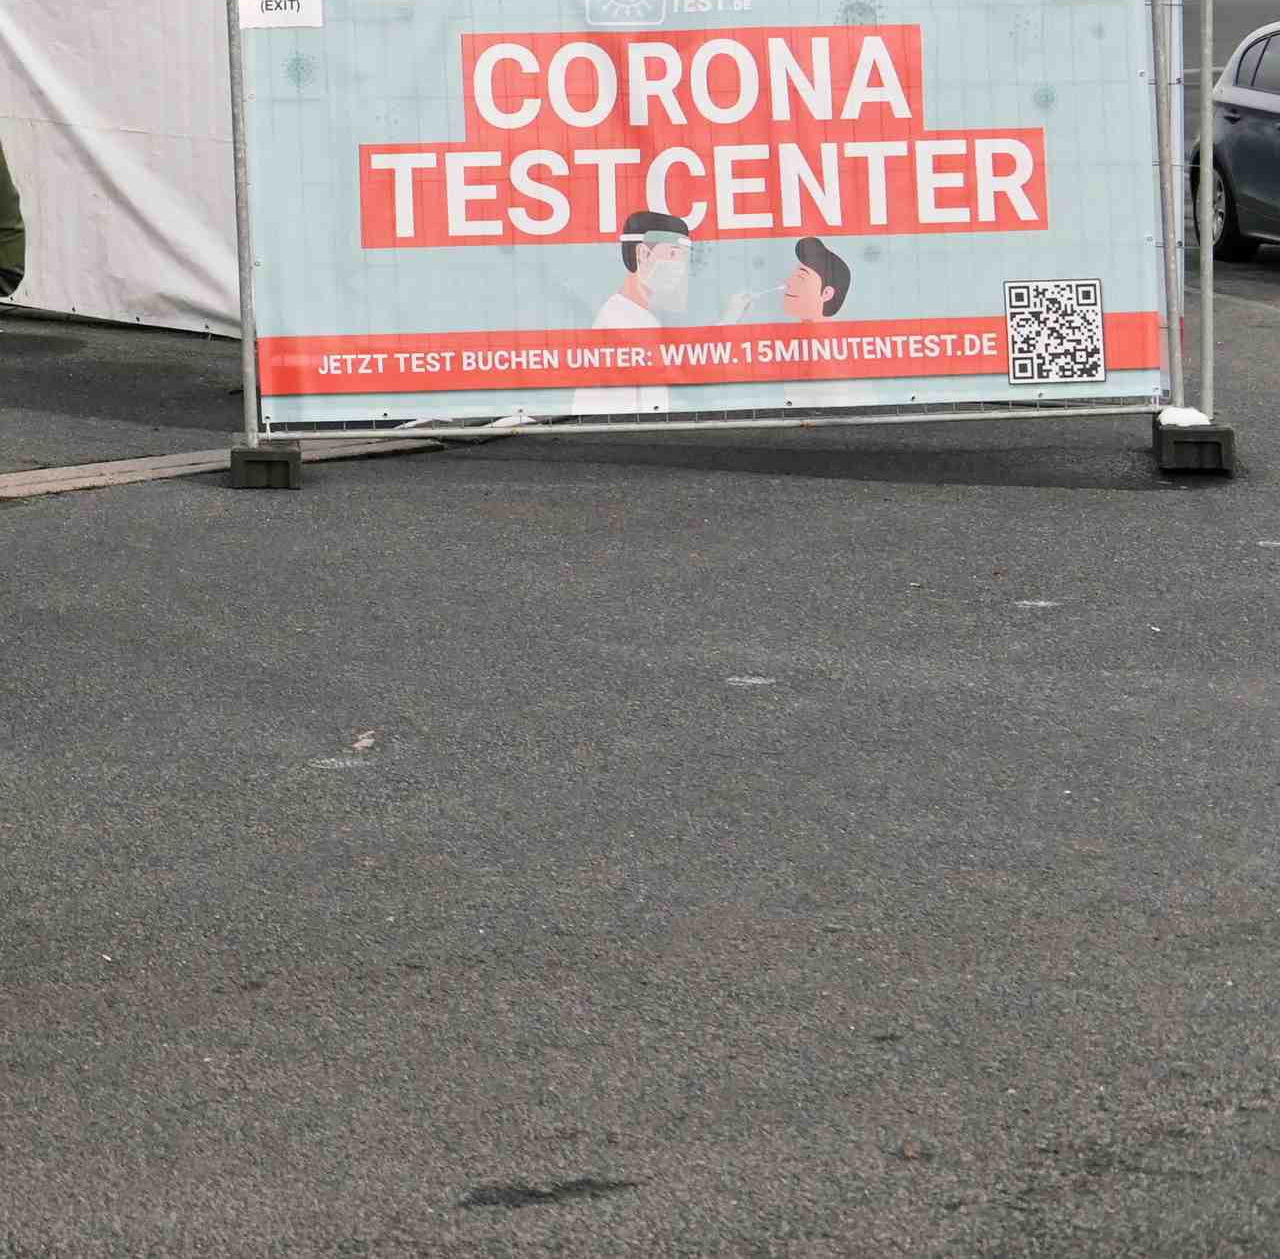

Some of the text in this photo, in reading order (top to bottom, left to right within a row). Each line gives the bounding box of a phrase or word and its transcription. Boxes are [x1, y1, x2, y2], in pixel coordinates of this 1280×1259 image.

[474, 37, 912, 131] CORONA
[371, 138, 1039, 238] TESTCENTER
[318, 333, 997, 375] JETZT TEST BUCHEN UNTER: WWW.15MINUTENTEST.DE
